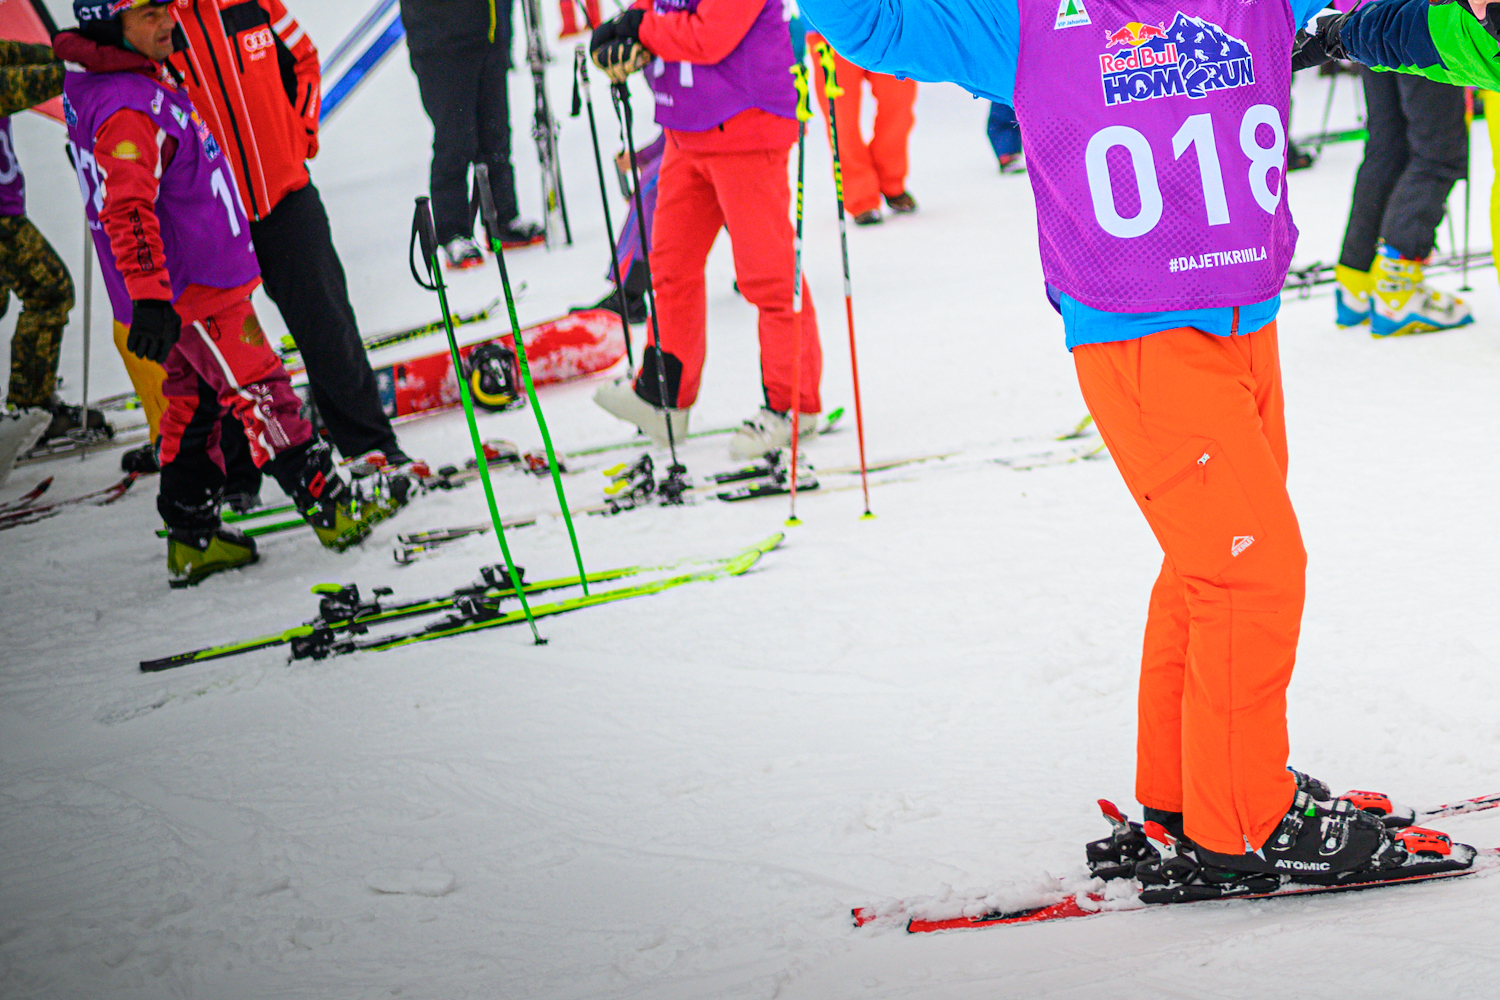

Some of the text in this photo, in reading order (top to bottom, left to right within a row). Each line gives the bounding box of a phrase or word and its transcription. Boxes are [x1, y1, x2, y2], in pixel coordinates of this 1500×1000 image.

[1100, 42, 1179, 74] Red Bull
[1085, 103, 1286, 239] 018
[1169, 246, 1268, 274] #DAJETIKRIIILA
[1274, 858, 1331, 871] ATOMIC
